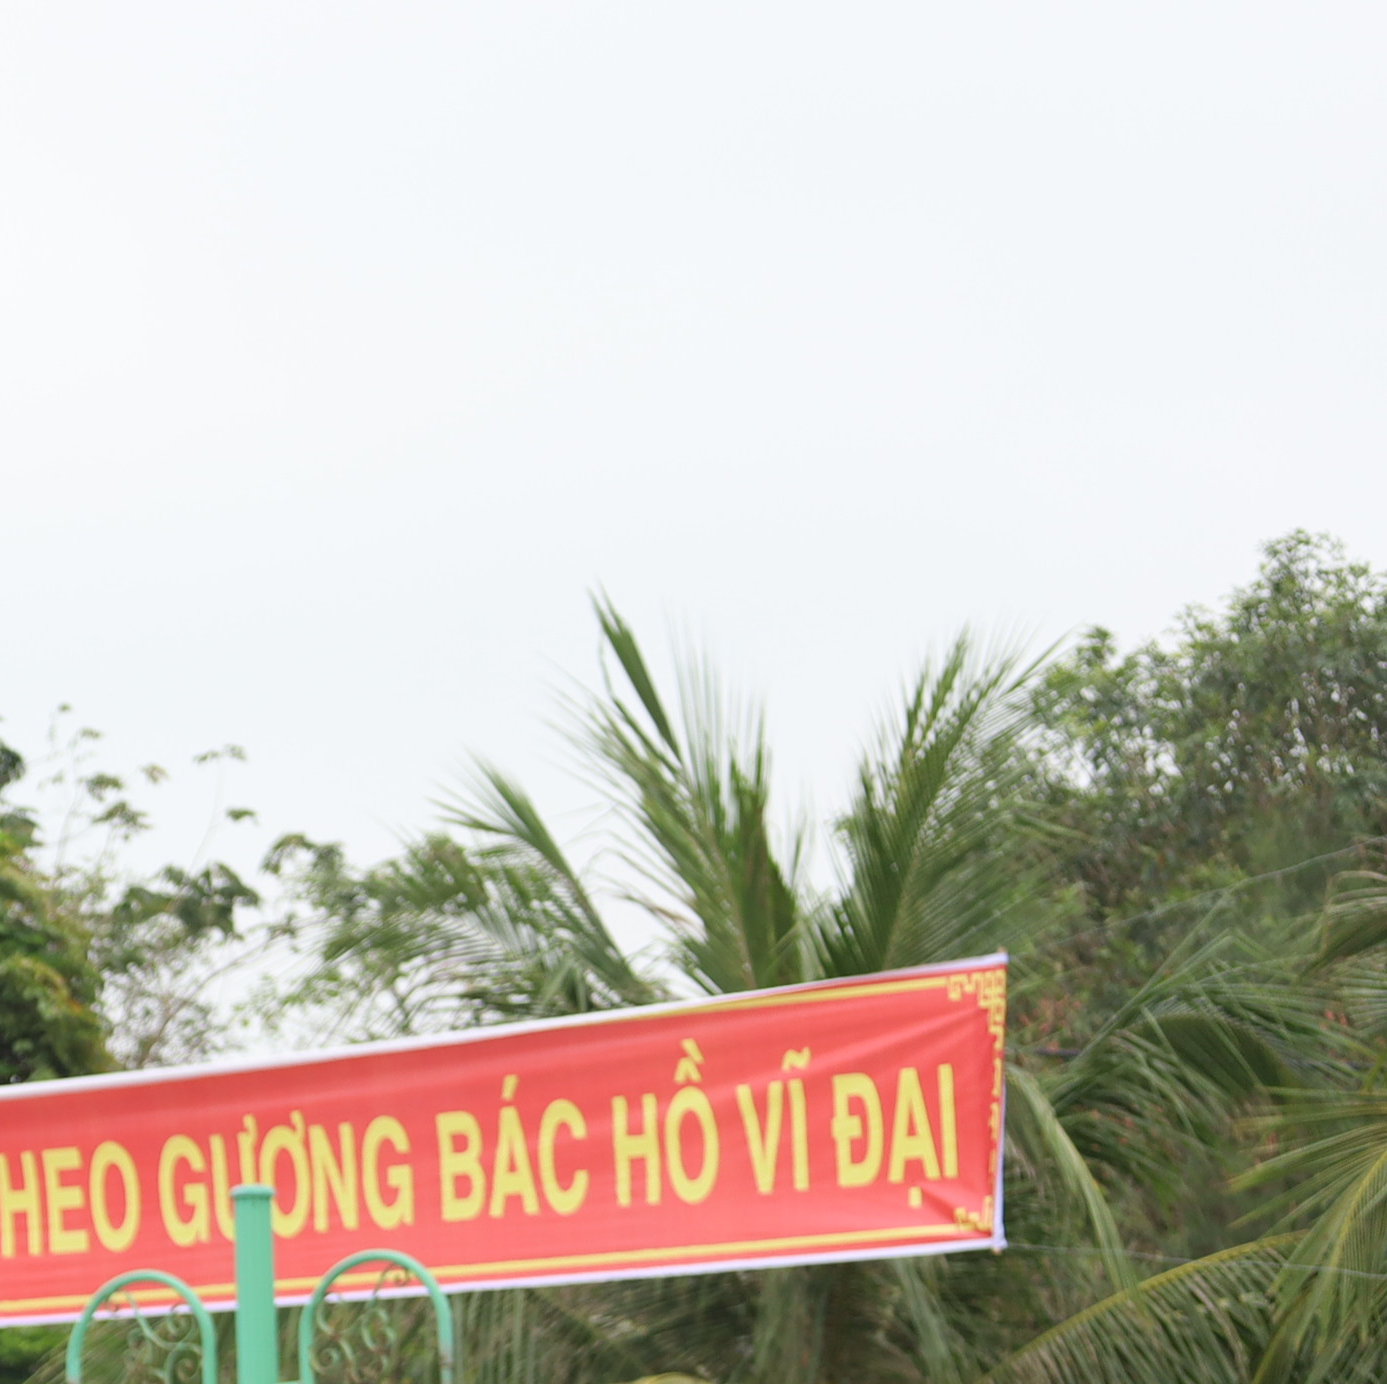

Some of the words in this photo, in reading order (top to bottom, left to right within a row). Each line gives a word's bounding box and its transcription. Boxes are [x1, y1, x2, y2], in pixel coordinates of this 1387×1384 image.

[158, 1111, 414, 1247] GƯƠNG
[436, 1074, 589, 1223] BÁC
[612, 1038, 721, 1207] HỒ
[737, 1047, 811, 1195] VĨ
[831, 1063, 959, 1208] ĐẠI
